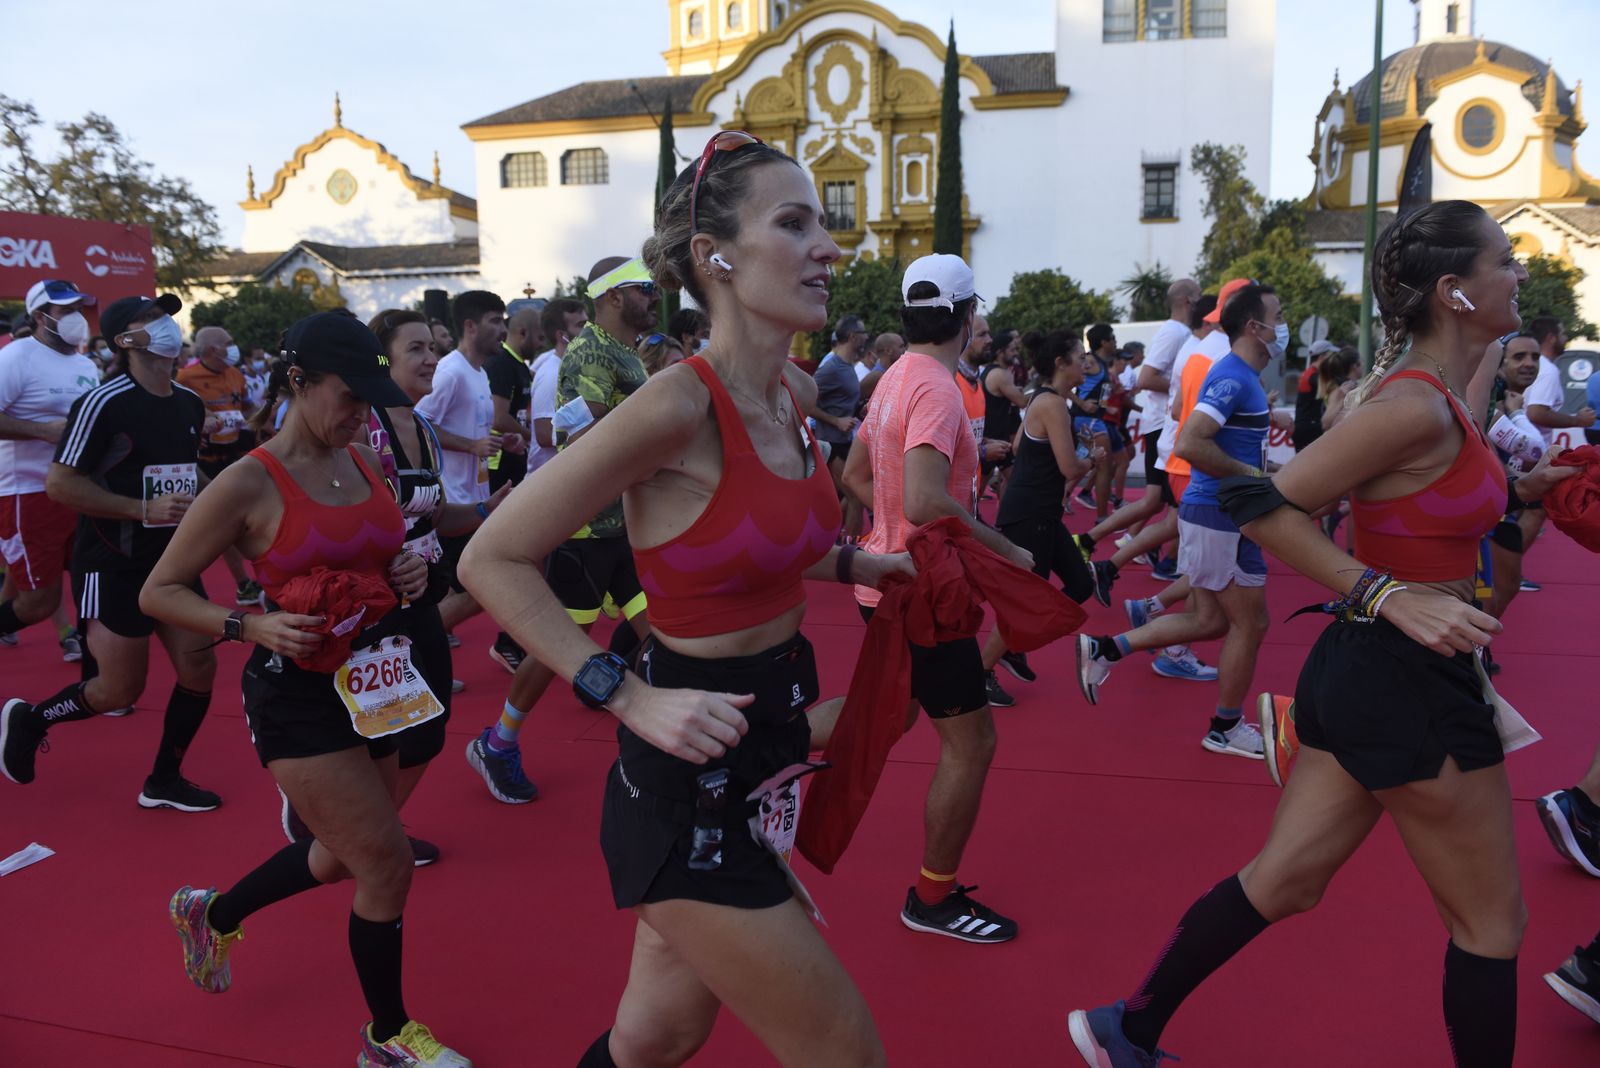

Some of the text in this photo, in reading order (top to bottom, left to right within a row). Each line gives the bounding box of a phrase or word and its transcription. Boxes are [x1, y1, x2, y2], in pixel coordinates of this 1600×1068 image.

[152, 478, 192, 497] 4926
[346, 657, 403, 695] 6266
[43, 699, 80, 720] WONG
